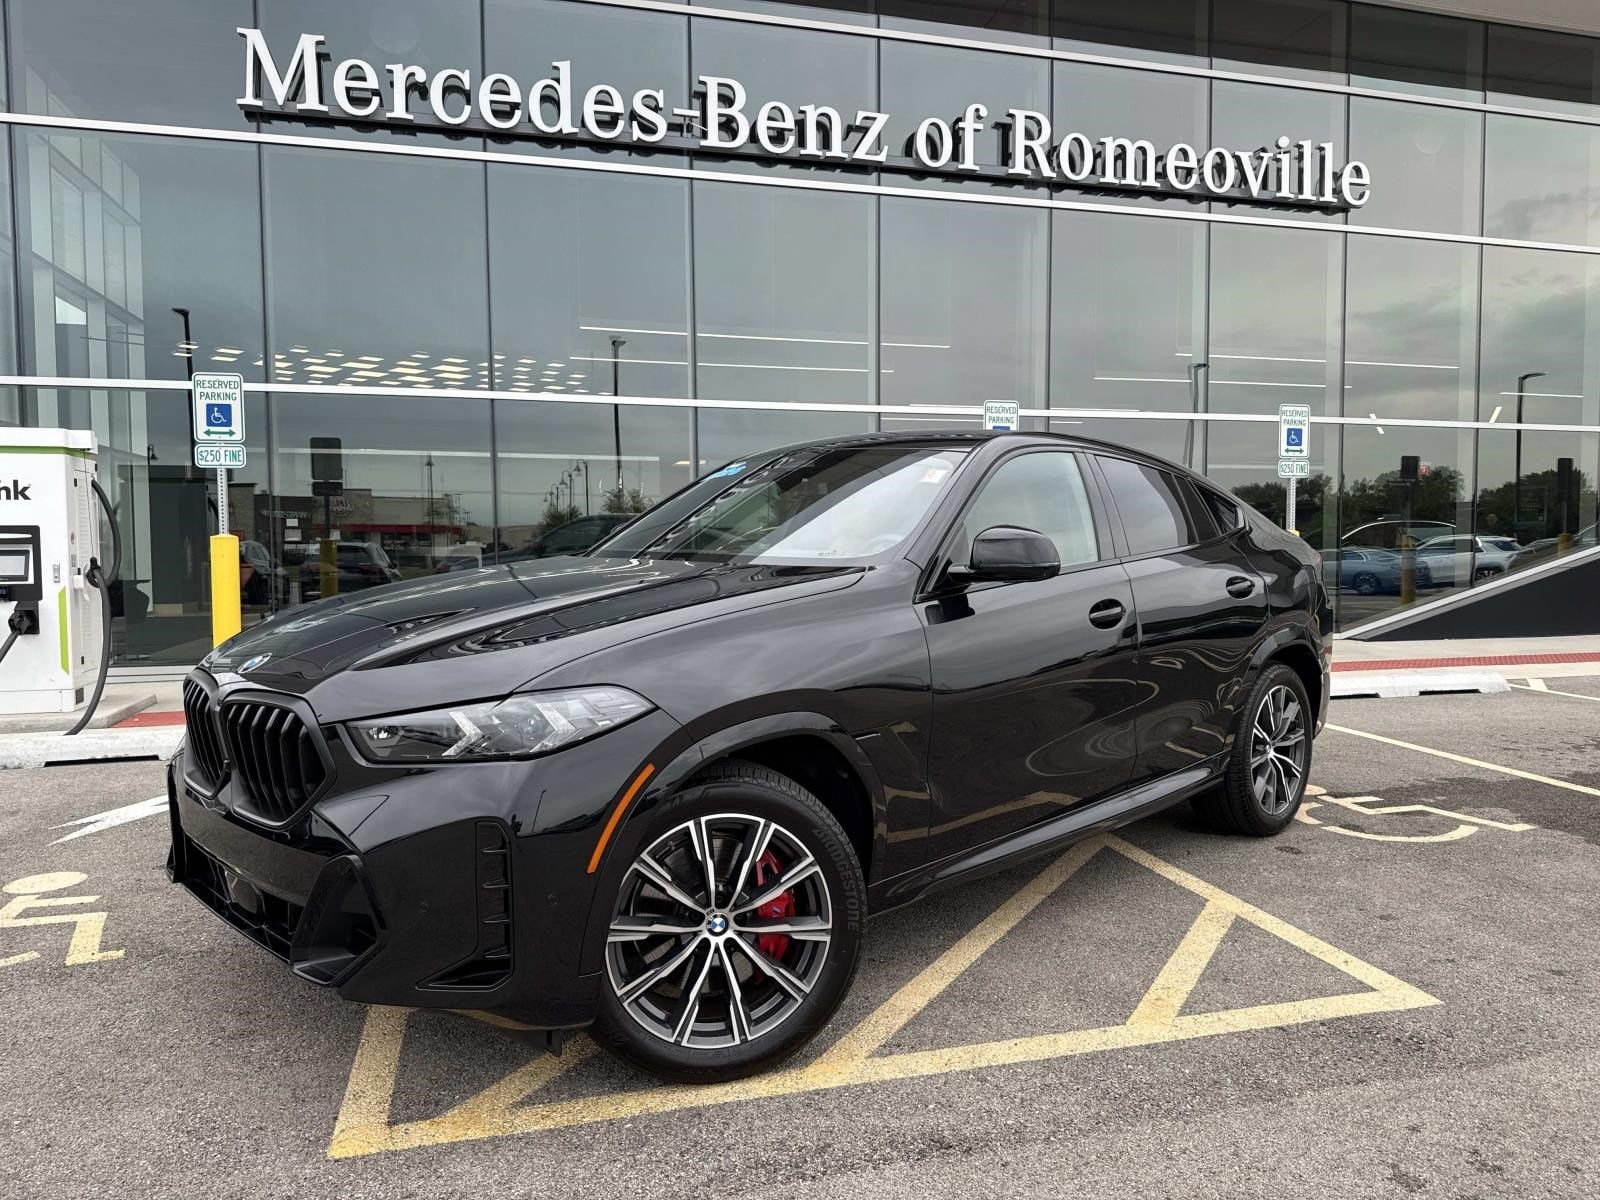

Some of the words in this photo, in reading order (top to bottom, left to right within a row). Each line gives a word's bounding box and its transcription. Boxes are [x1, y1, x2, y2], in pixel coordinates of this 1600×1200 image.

[236, 27, 890, 162] Mercedes-Benz
[916, 103, 988, 171] of
[1008, 108, 1371, 206] Romeoville
[197, 379, 240, 389] RESERVED
[199, 392, 237, 401] PARKING
[986, 406, 1016, 414] RESERVED
[1281, 410, 1308, 418] RESERVED
[988, 415, 1015, 424] PARKING
[198, 449, 221, 462] $250
[224, 450, 242, 462] FINE
[1280, 463, 1294, 474] $250
[1296, 463, 1307, 474] FINE
